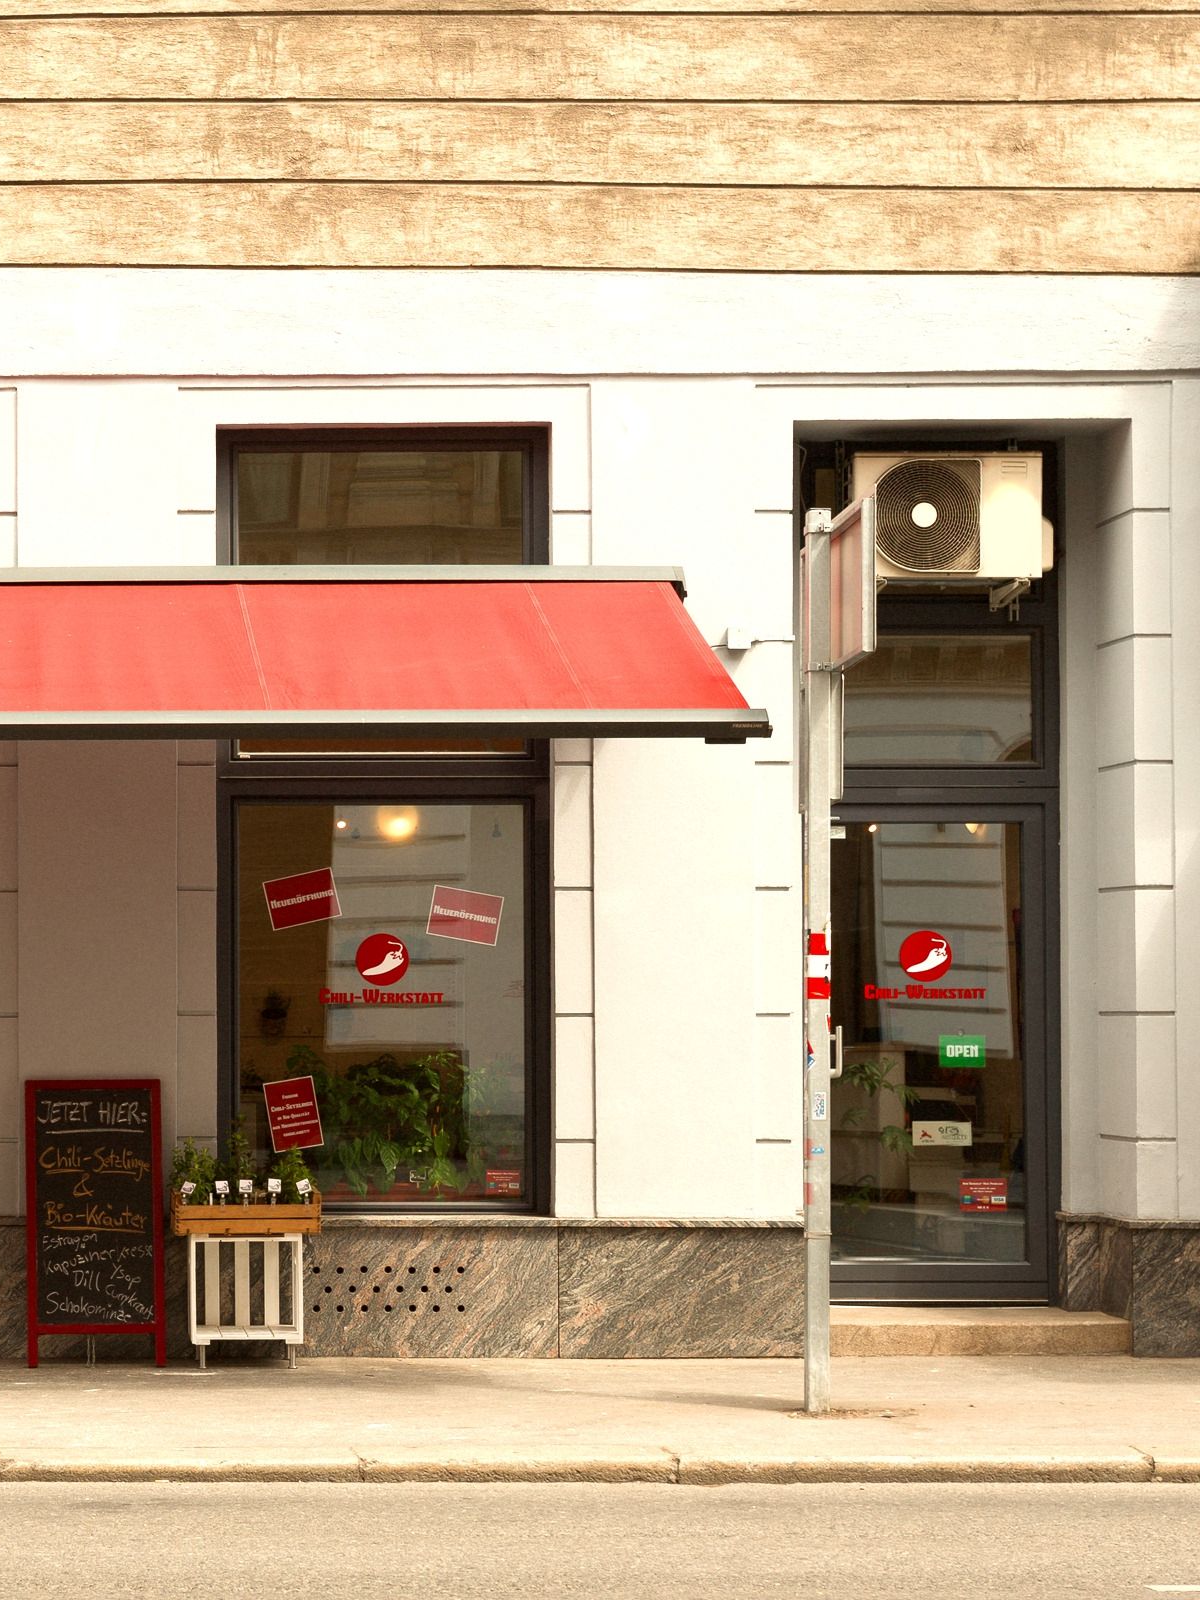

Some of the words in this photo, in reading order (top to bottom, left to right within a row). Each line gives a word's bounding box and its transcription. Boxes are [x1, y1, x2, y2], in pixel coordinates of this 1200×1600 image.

[946, 1044, 979, 1058] OPEN
[37, 1101, 93, 1124] JETZT
[98, 1101, 148, 1125] HIER:
[72, 1173, 94, 1198] &
[43, 1201, 148, 1229] Bio-Kräuter
[72, 1270, 100, 1291] Dill
[46, 1291, 131, 1323] Schokominze
